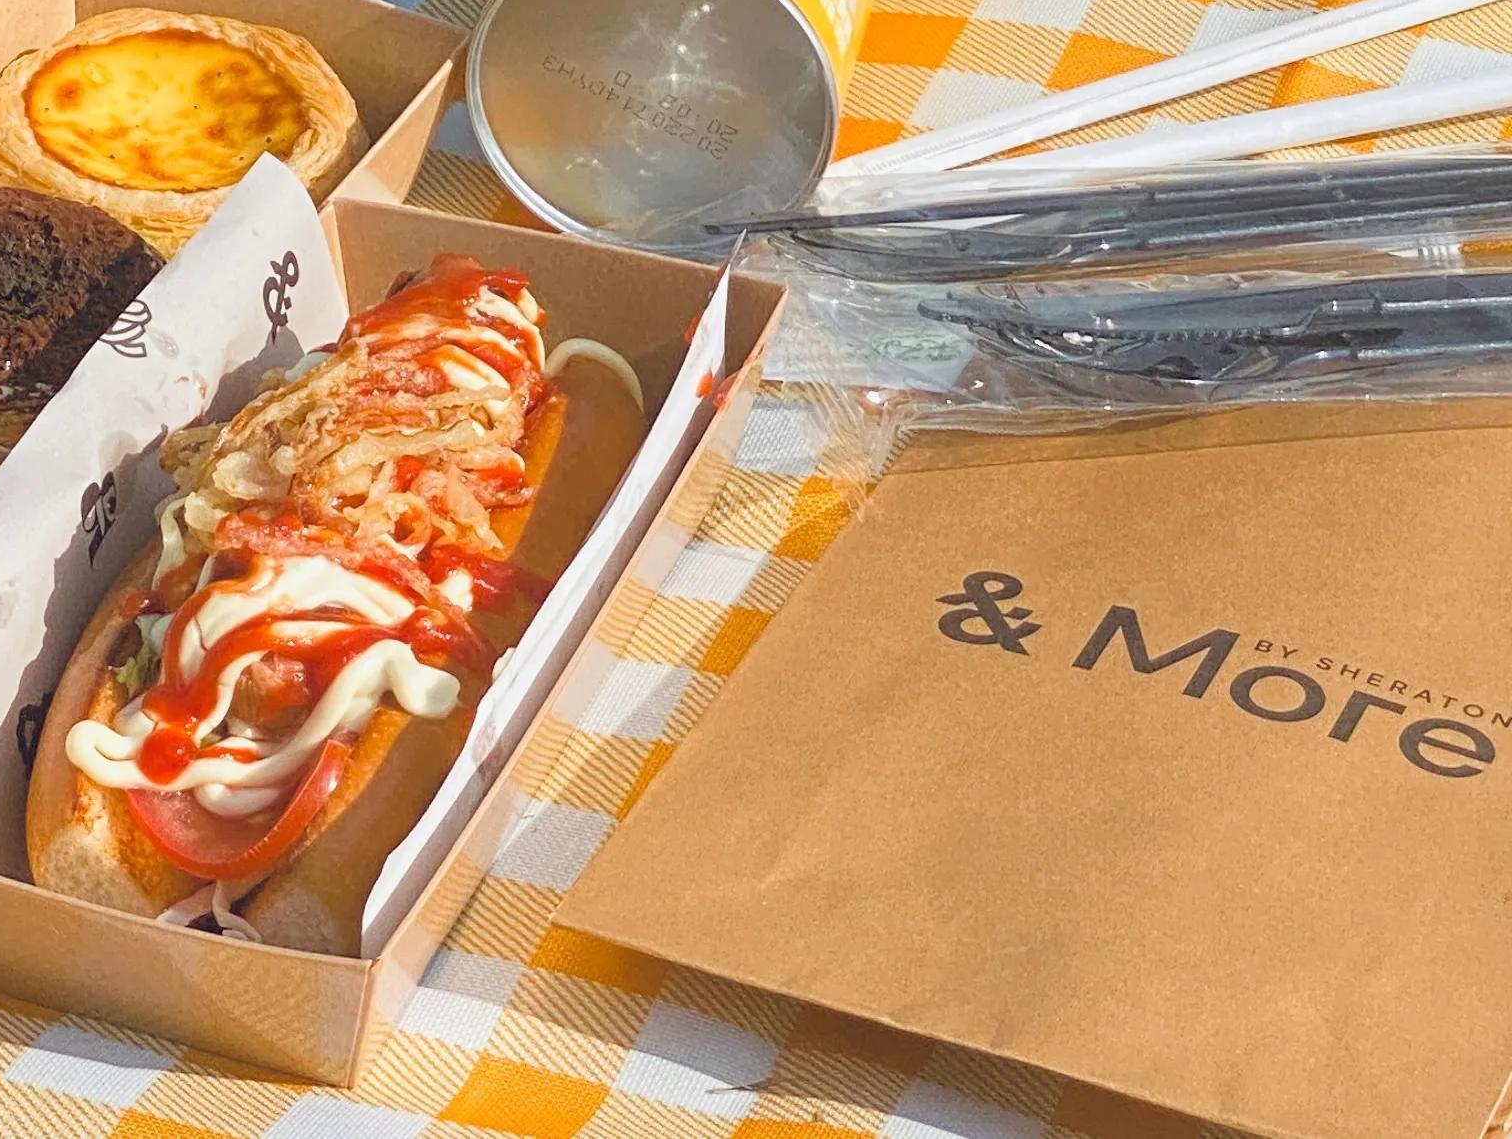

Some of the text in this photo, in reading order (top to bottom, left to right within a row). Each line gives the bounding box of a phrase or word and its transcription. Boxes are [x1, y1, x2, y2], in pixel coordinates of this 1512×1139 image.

[1071, 604, 1497, 779] More
[1254, 639, 1512, 729] BY SHERATON
